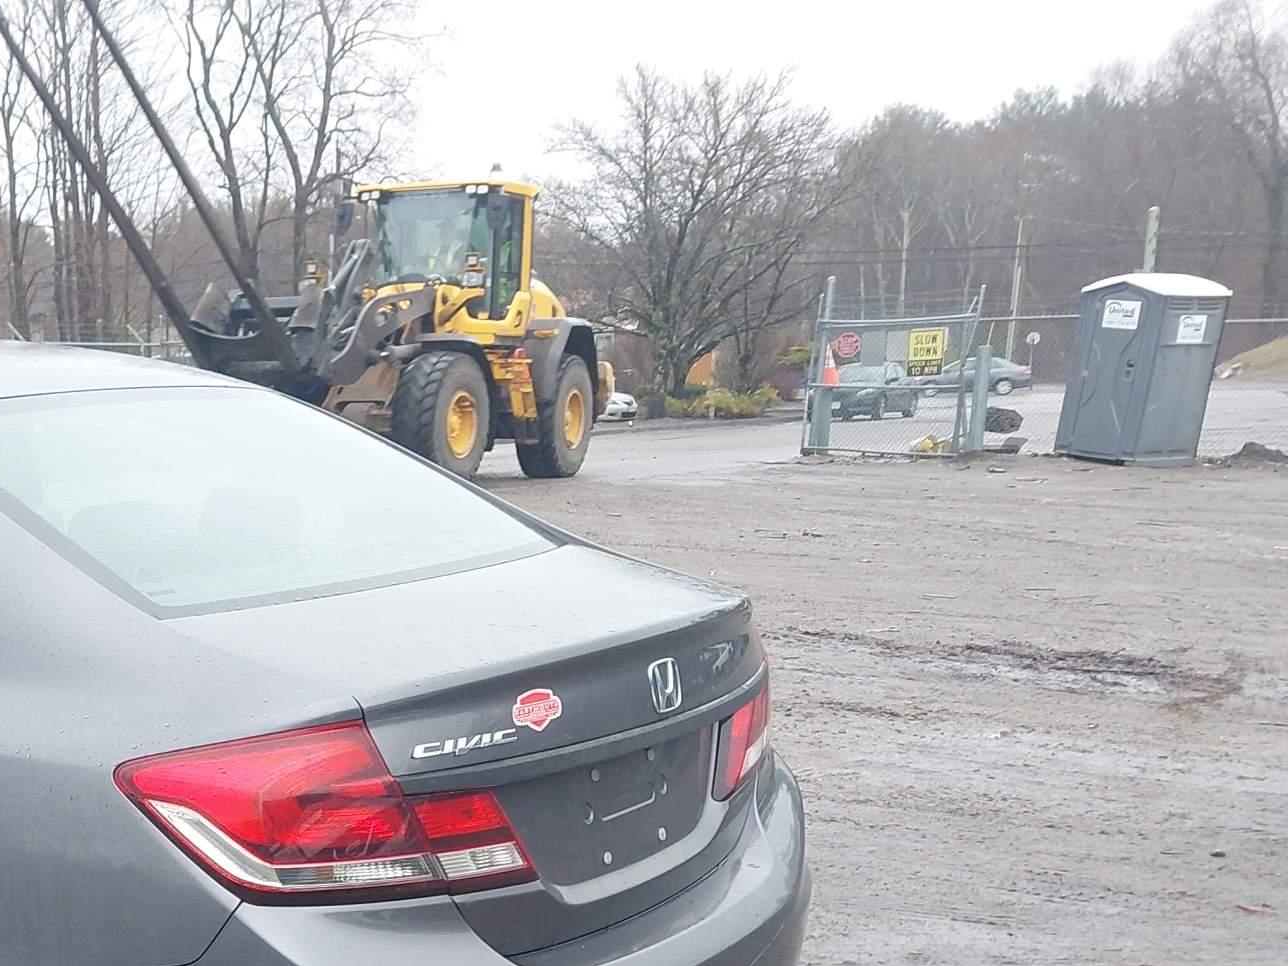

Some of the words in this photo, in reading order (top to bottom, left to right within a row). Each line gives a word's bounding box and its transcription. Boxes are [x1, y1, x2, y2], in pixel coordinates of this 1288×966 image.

[1108, 306, 1136, 315] United
[914, 335, 937, 345] SLOW
[913, 346, 938, 357] DOWN
[911, 366, 921, 375] 10
[924, 365, 938, 375] MPH
[411, 728, 518, 759] CIVIC
